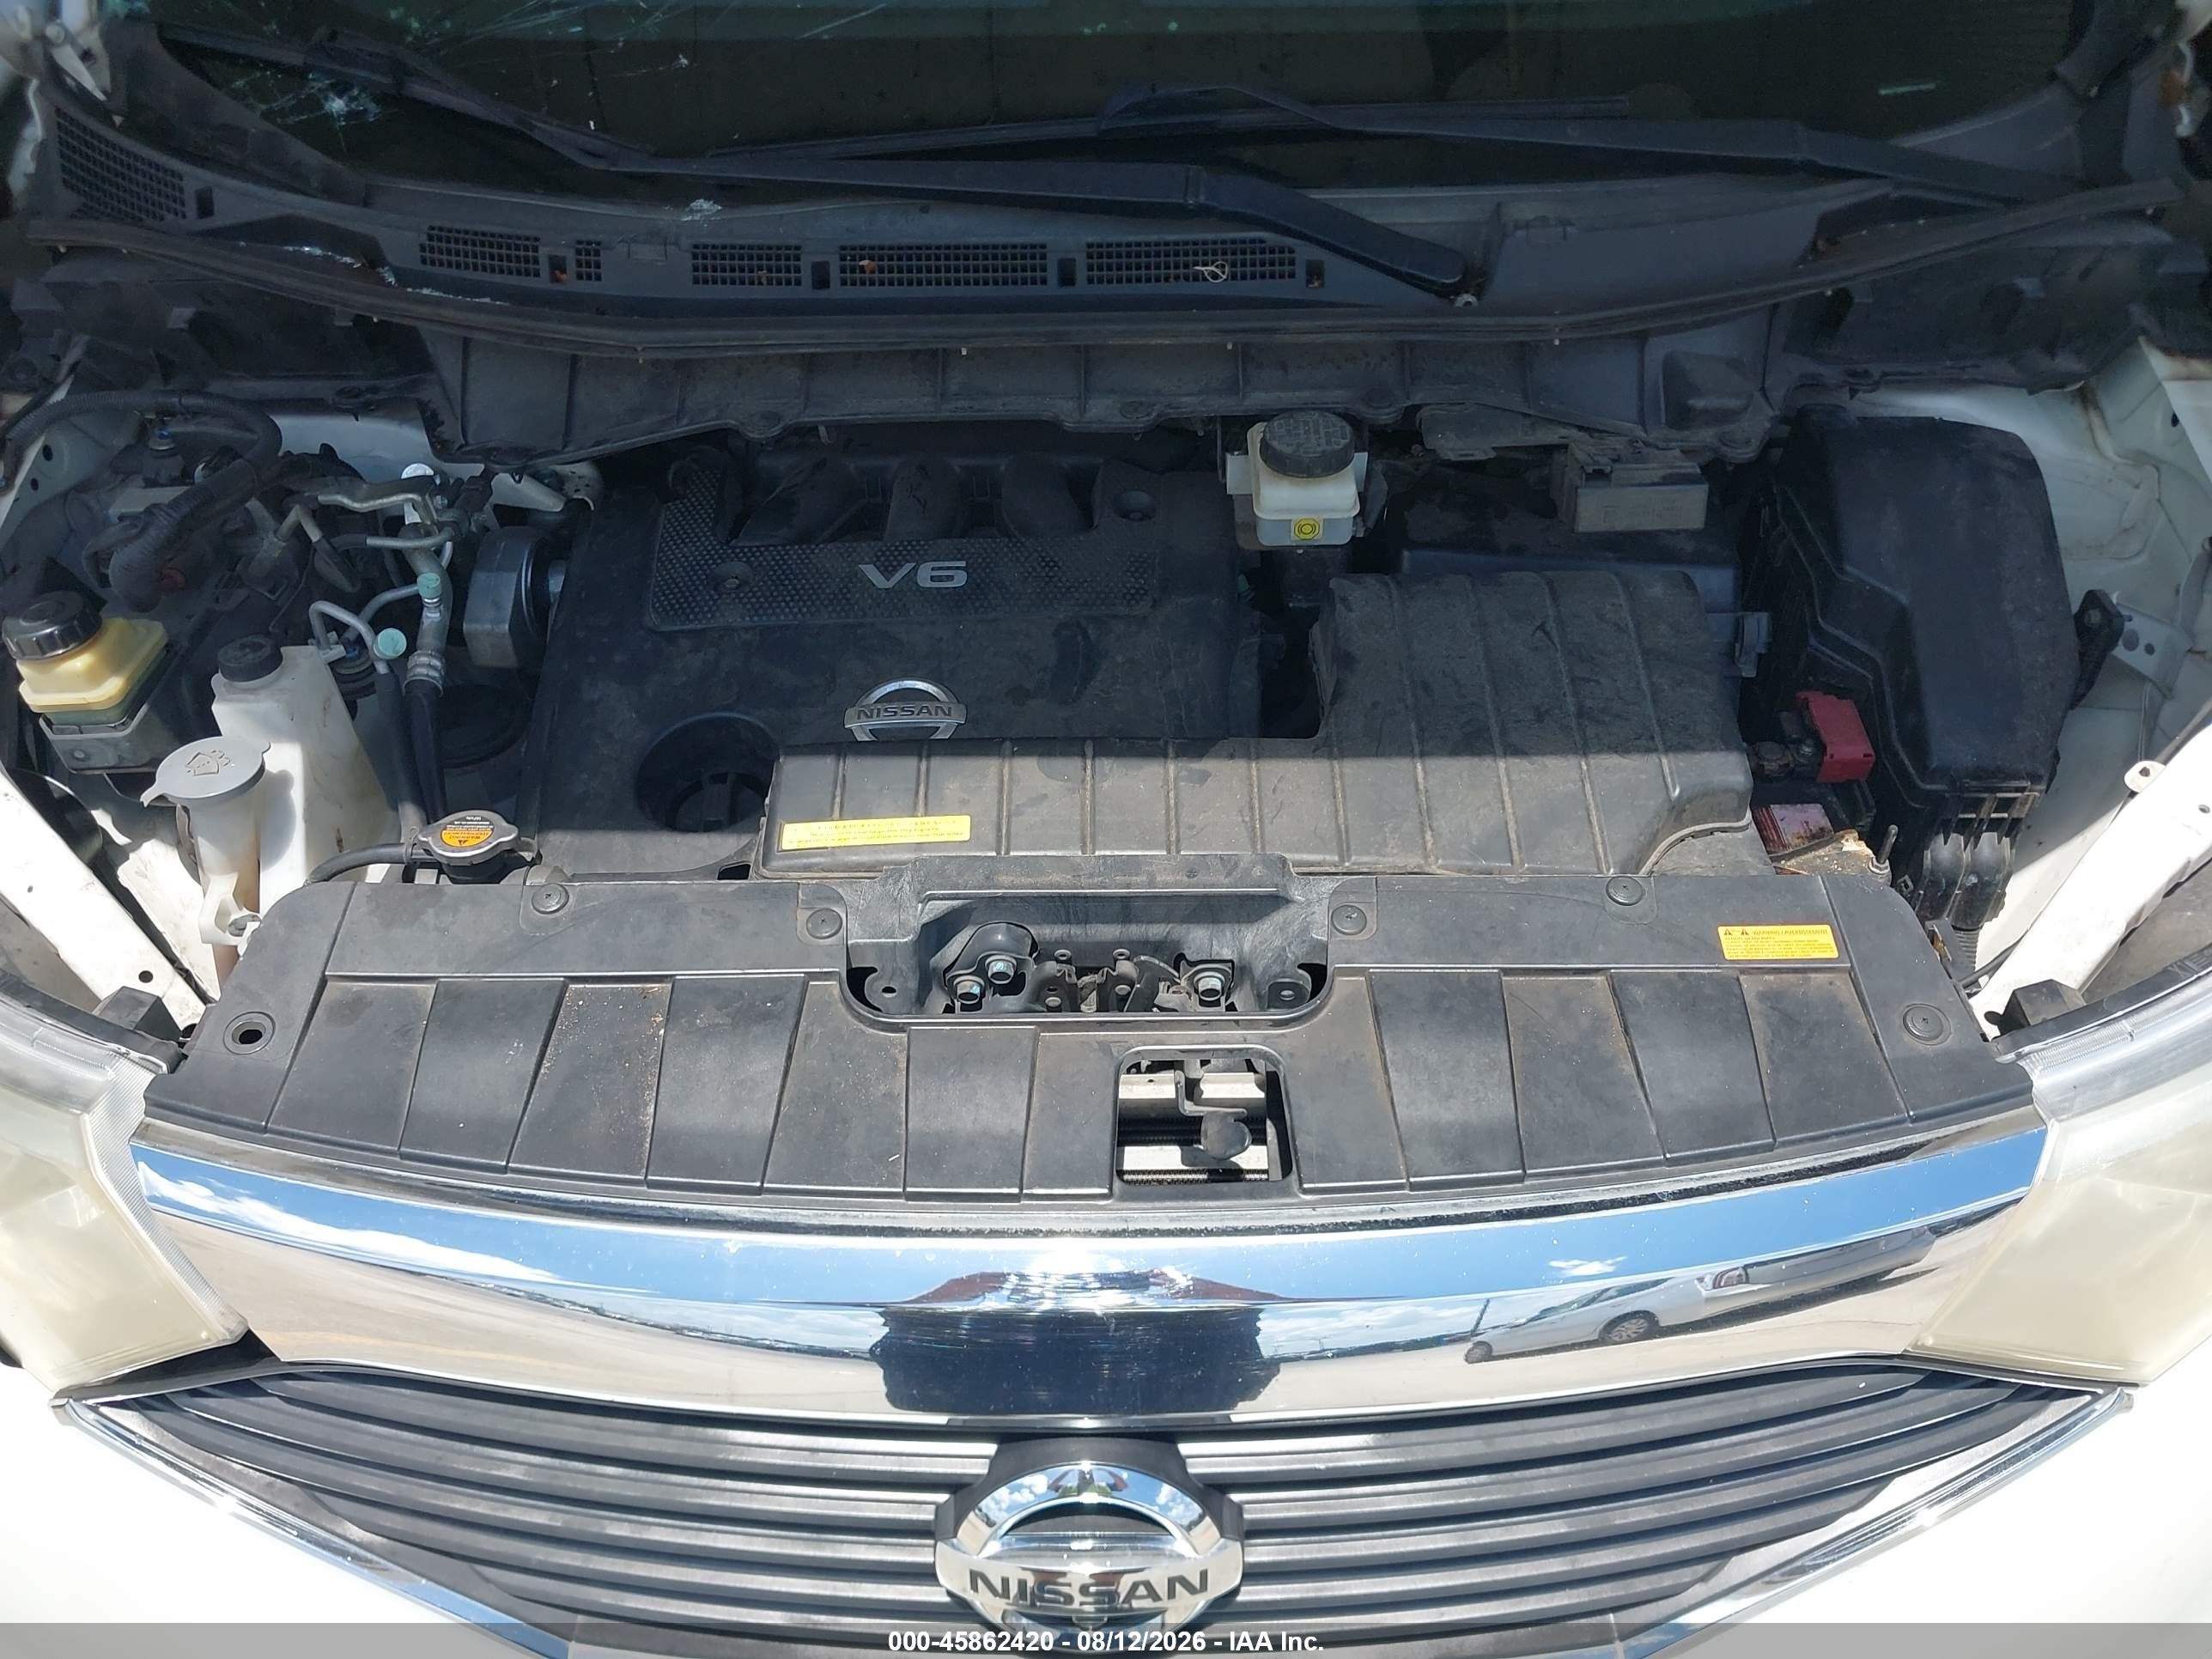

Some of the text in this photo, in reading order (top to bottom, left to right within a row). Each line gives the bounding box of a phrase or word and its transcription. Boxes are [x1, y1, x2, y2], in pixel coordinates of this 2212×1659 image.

[858, 561, 968, 589] V6
[857, 705, 952, 720] NISSAN
[969, 1569, 1208, 1608] NISSAN
